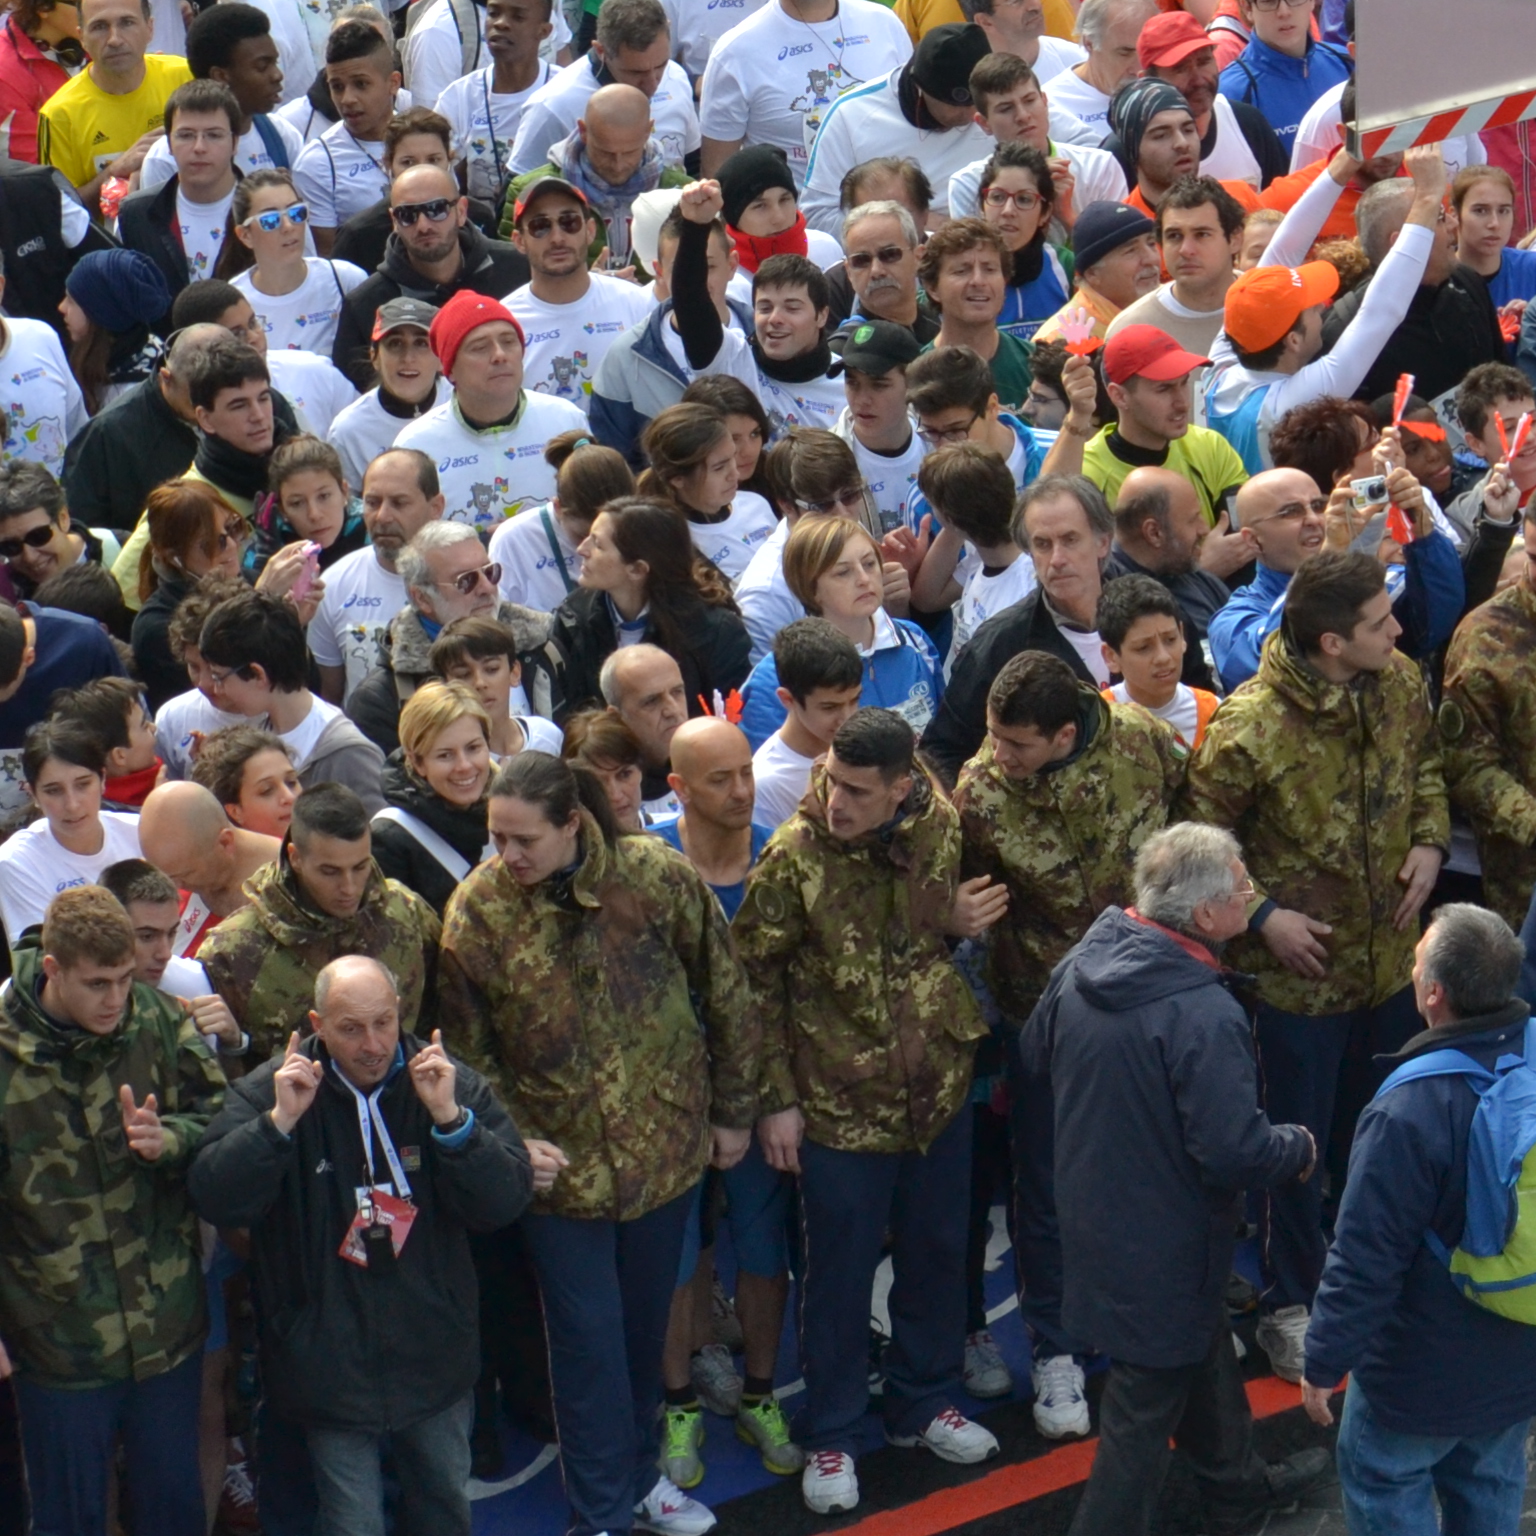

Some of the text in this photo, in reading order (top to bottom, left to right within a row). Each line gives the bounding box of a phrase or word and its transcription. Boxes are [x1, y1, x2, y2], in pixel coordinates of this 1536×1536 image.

[790, 42, 815, 56] asics
[533, 328, 561, 342] asics
[452, 453, 480, 470] asics
[357, 594, 383, 608] asics
